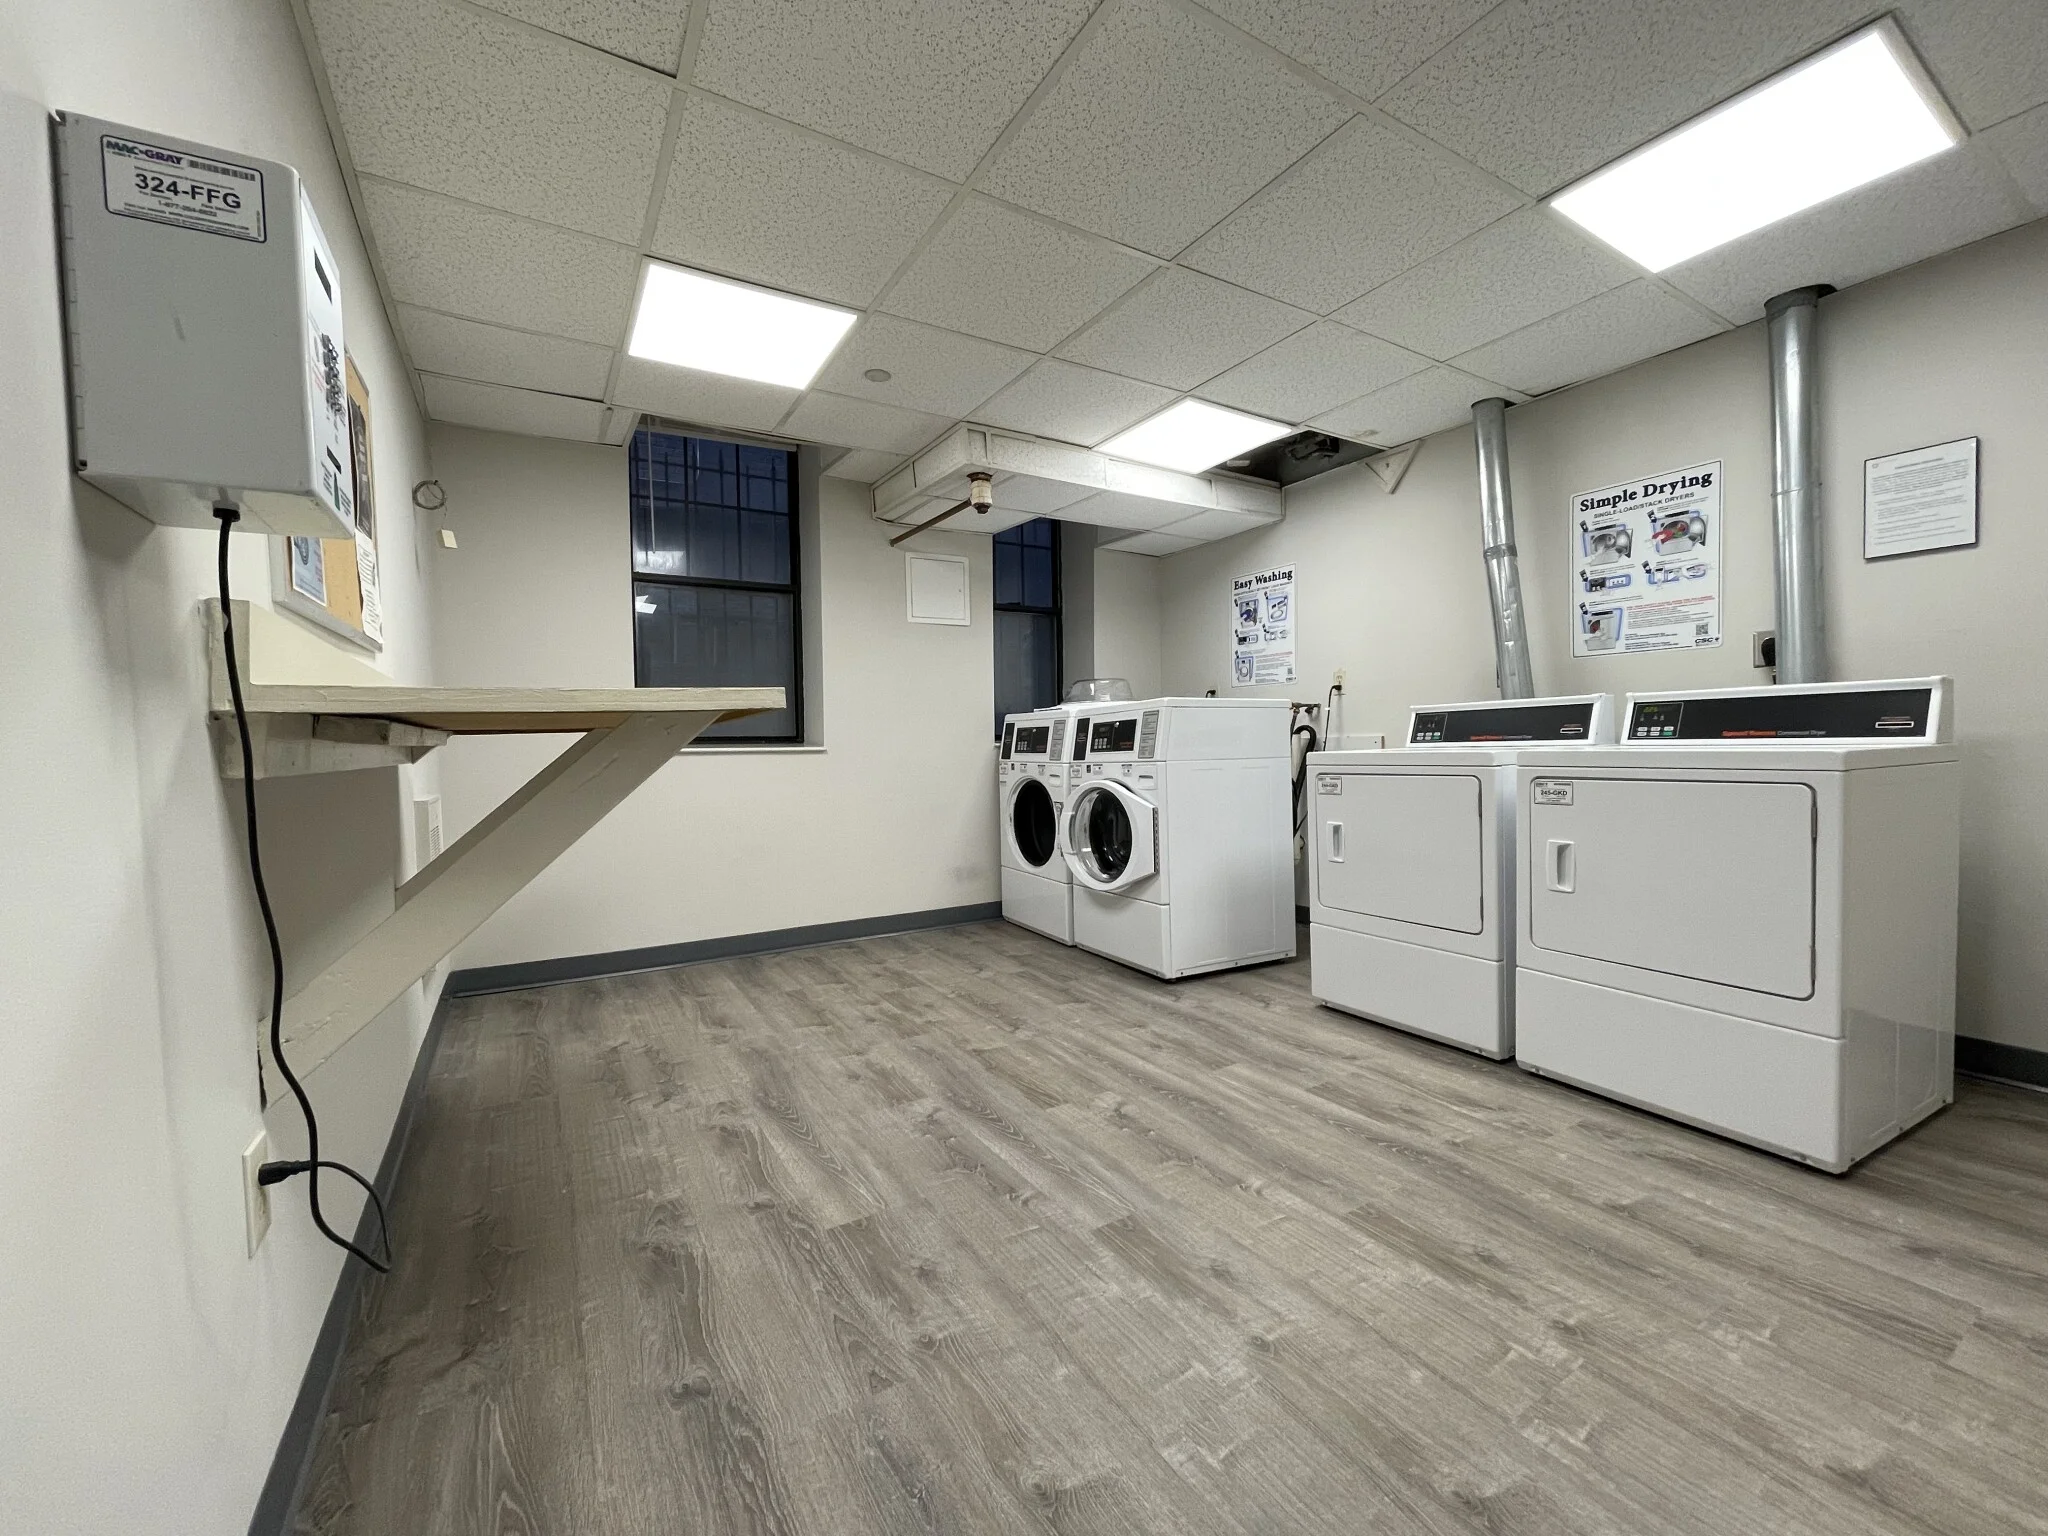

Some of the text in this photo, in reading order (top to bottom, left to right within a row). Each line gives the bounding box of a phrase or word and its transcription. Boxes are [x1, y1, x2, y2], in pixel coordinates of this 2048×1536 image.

[106, 140, 184, 164] MAC-GRAY
[135, 173, 241, 209] 324-FFG
[1580, 489, 1638, 512] Simple
[1642, 472, 1713, 498] Drying
[1664, 492, 1695, 504] DRYERS
[1234, 579, 1253, 590] Easy
[1255, 570, 1293, 585] Washing
